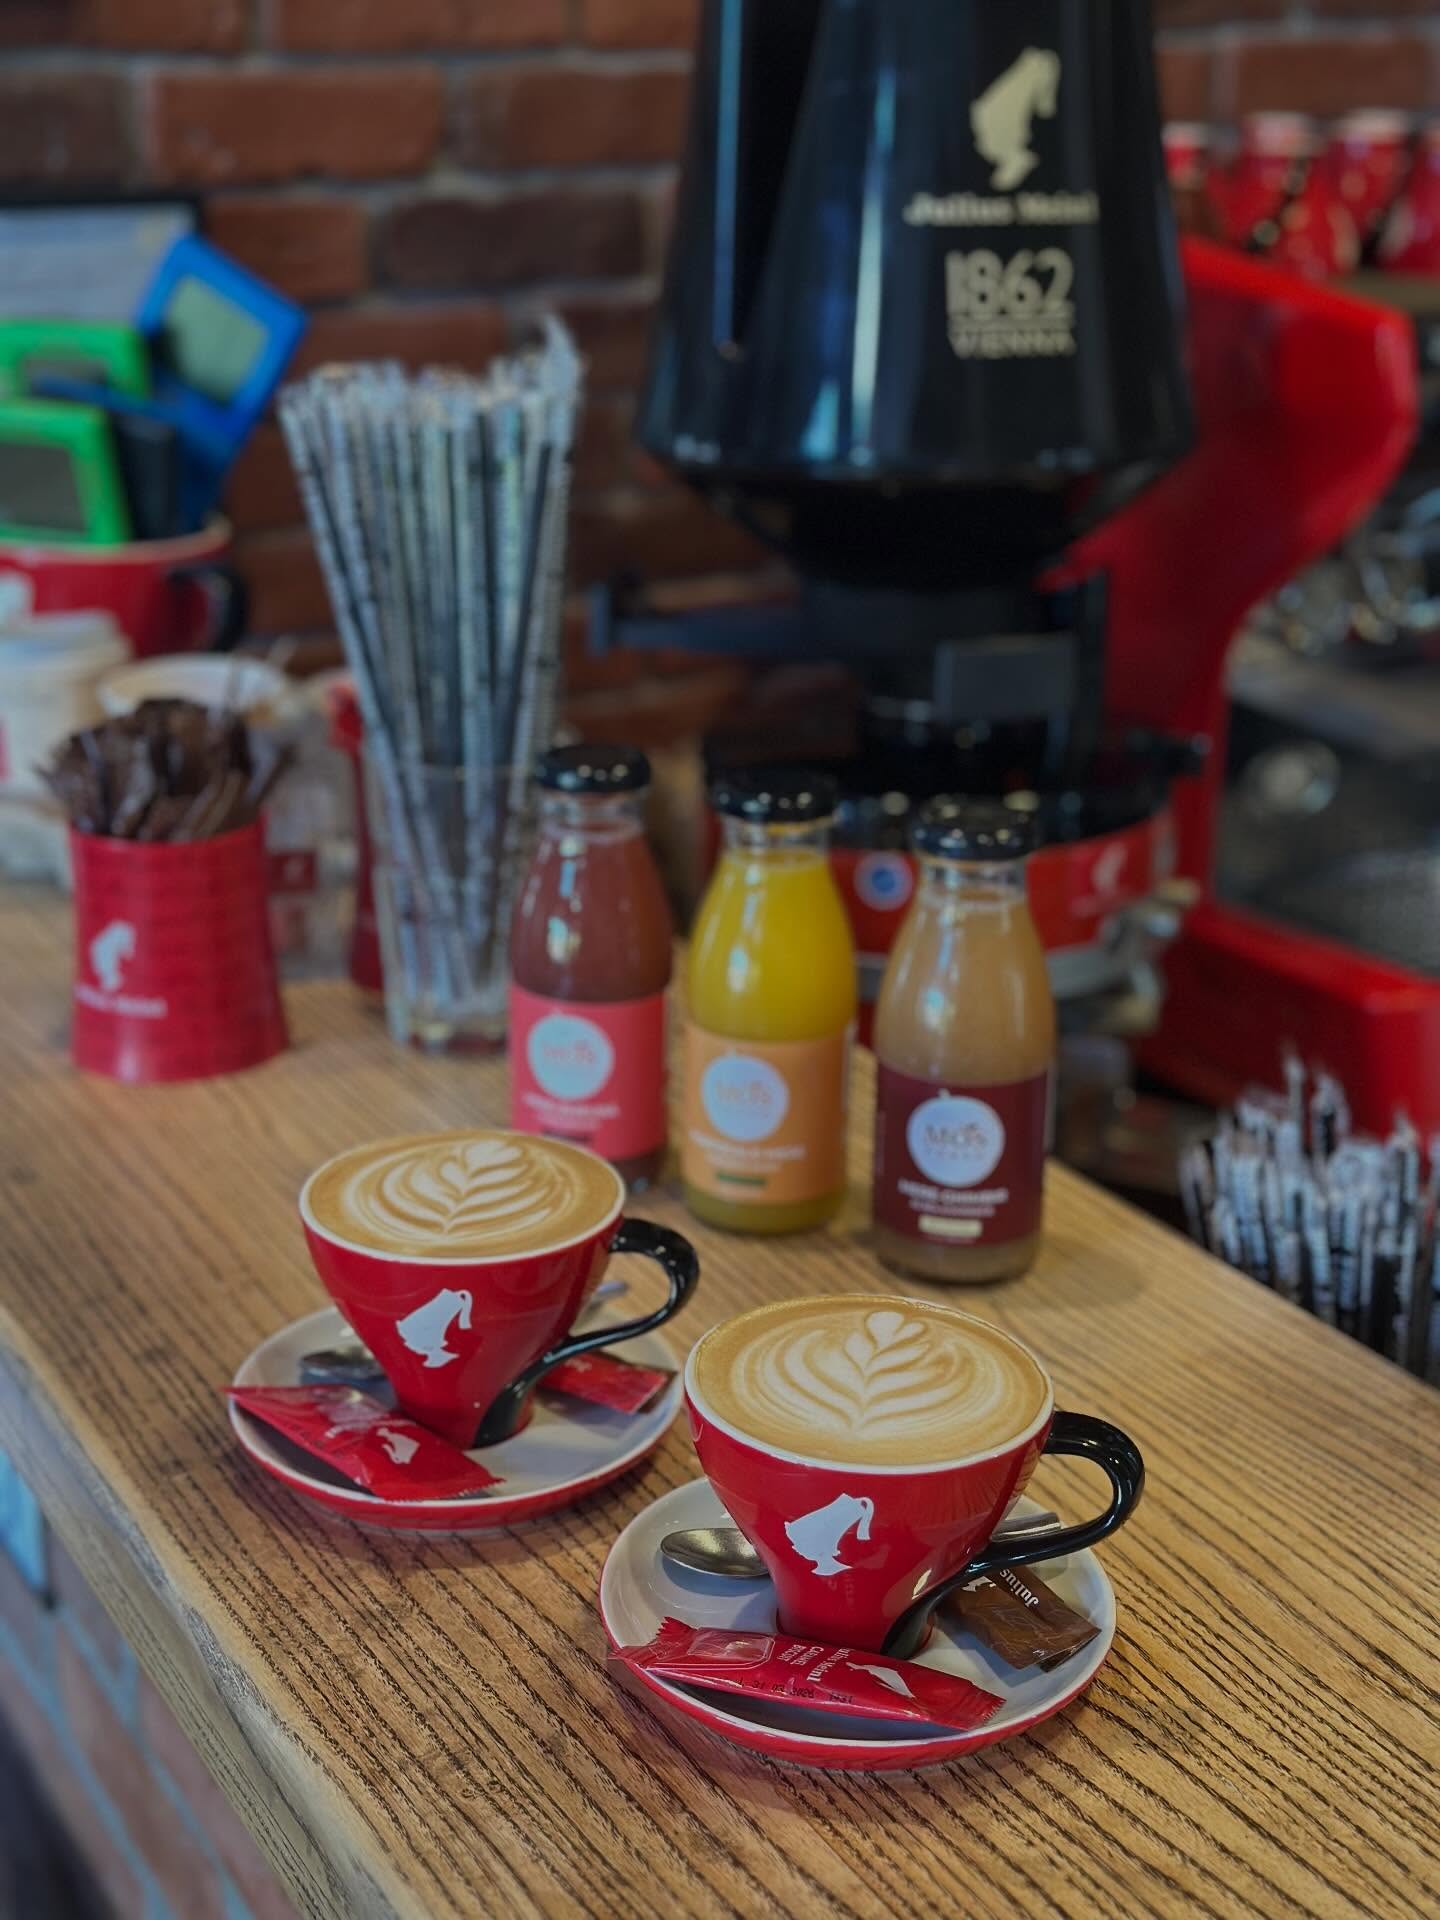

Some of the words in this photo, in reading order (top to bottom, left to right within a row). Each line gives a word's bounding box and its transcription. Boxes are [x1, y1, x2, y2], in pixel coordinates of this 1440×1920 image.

[903, 191, 1014, 227] Julius
[944, 248, 1074, 321] 1862
[948, 331, 1077, 359] VIENNA
[1000, 1568, 1040, 1607] Julius
